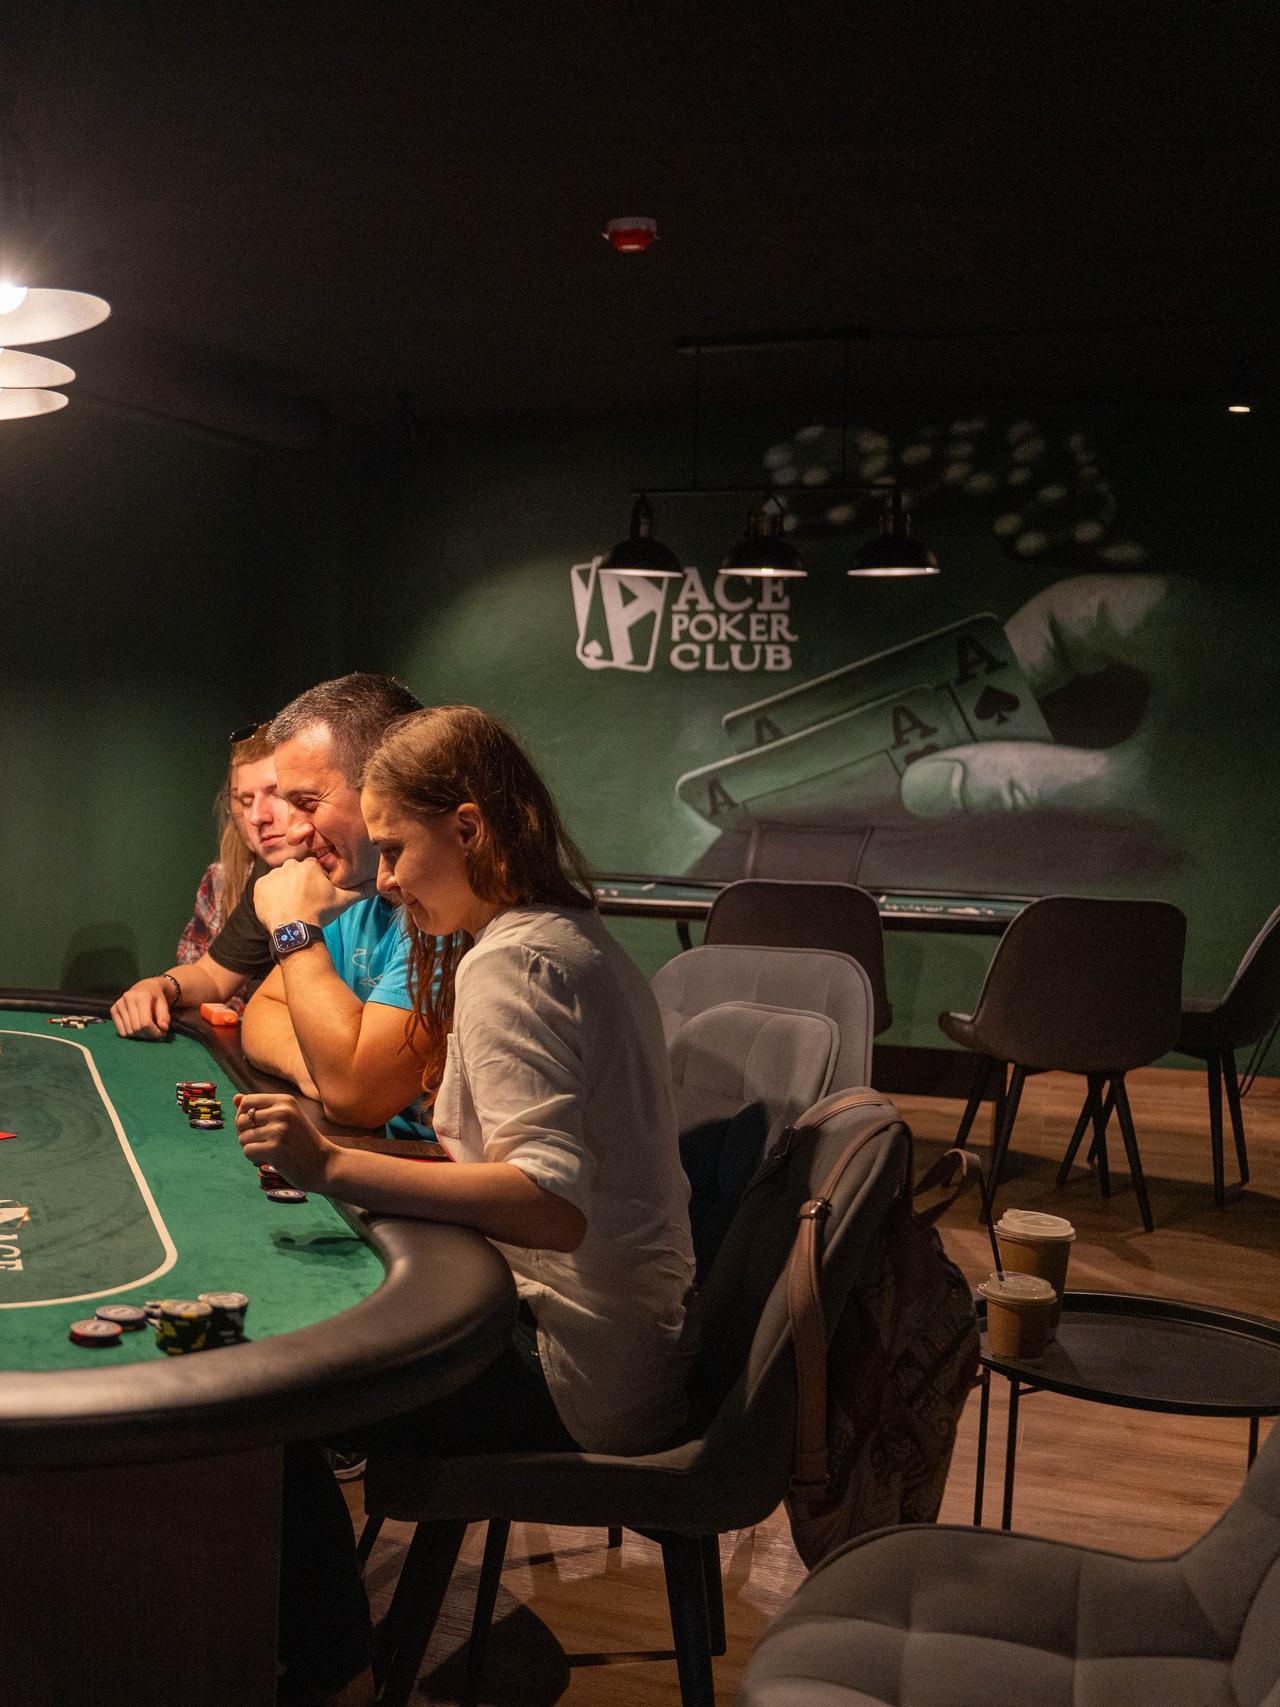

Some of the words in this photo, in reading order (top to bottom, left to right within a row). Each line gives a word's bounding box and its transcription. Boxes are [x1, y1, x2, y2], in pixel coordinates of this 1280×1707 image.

[671, 566, 792, 612] ACE
[671, 612, 799, 642] POKER
[670, 643, 793, 671] CLUB
[955, 633, 1008, 686] A
[891, 704, 939, 751] A
[706, 776, 740, 818] A
